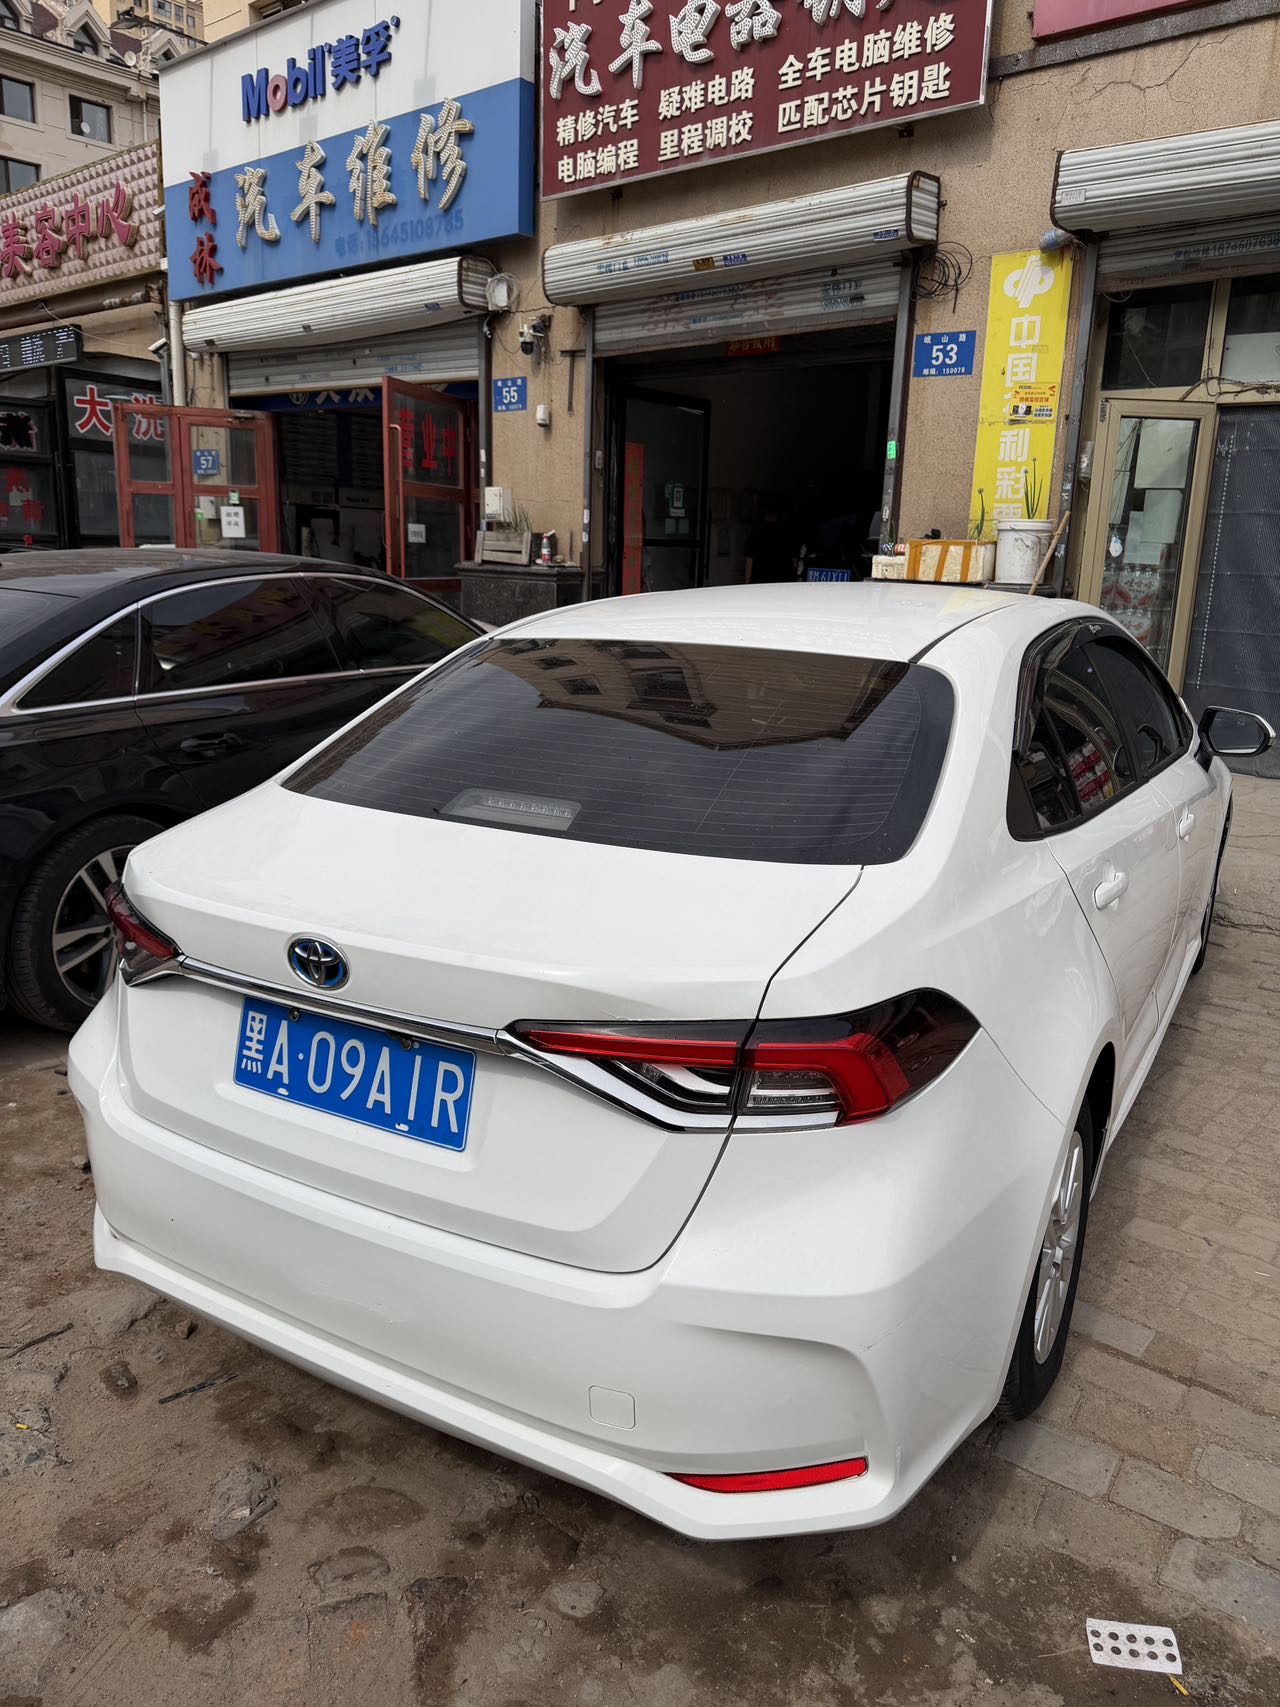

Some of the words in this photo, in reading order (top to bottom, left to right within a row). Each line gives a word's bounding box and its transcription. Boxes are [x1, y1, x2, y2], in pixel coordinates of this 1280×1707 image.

[241, 45, 328, 123] Mobil
[331, 22, 393, 91] 美孚
[547, 0, 892, 100] 汽车电器
[777, 11, 956, 91] 全车电脑维修
[556, 98, 640, 147] 精修汽车
[658, 66, 755, 121] 疑难电路
[777, 62, 952, 134] 匹配芯片钥匙
[557, 138, 640, 184] 电脑编程
[657, 111, 755, 163] 里程调校
[235, 96, 476, 250] 汽车维修
[0, 180, 139, 278] 美容中心
[931, 343, 958, 366] 53
[502, 386, 518, 404] 55
[993, 312, 1042, 520] 中国利彩
[200, 456, 213, 469] 57
[400, 409, 456, 477] 营业中
